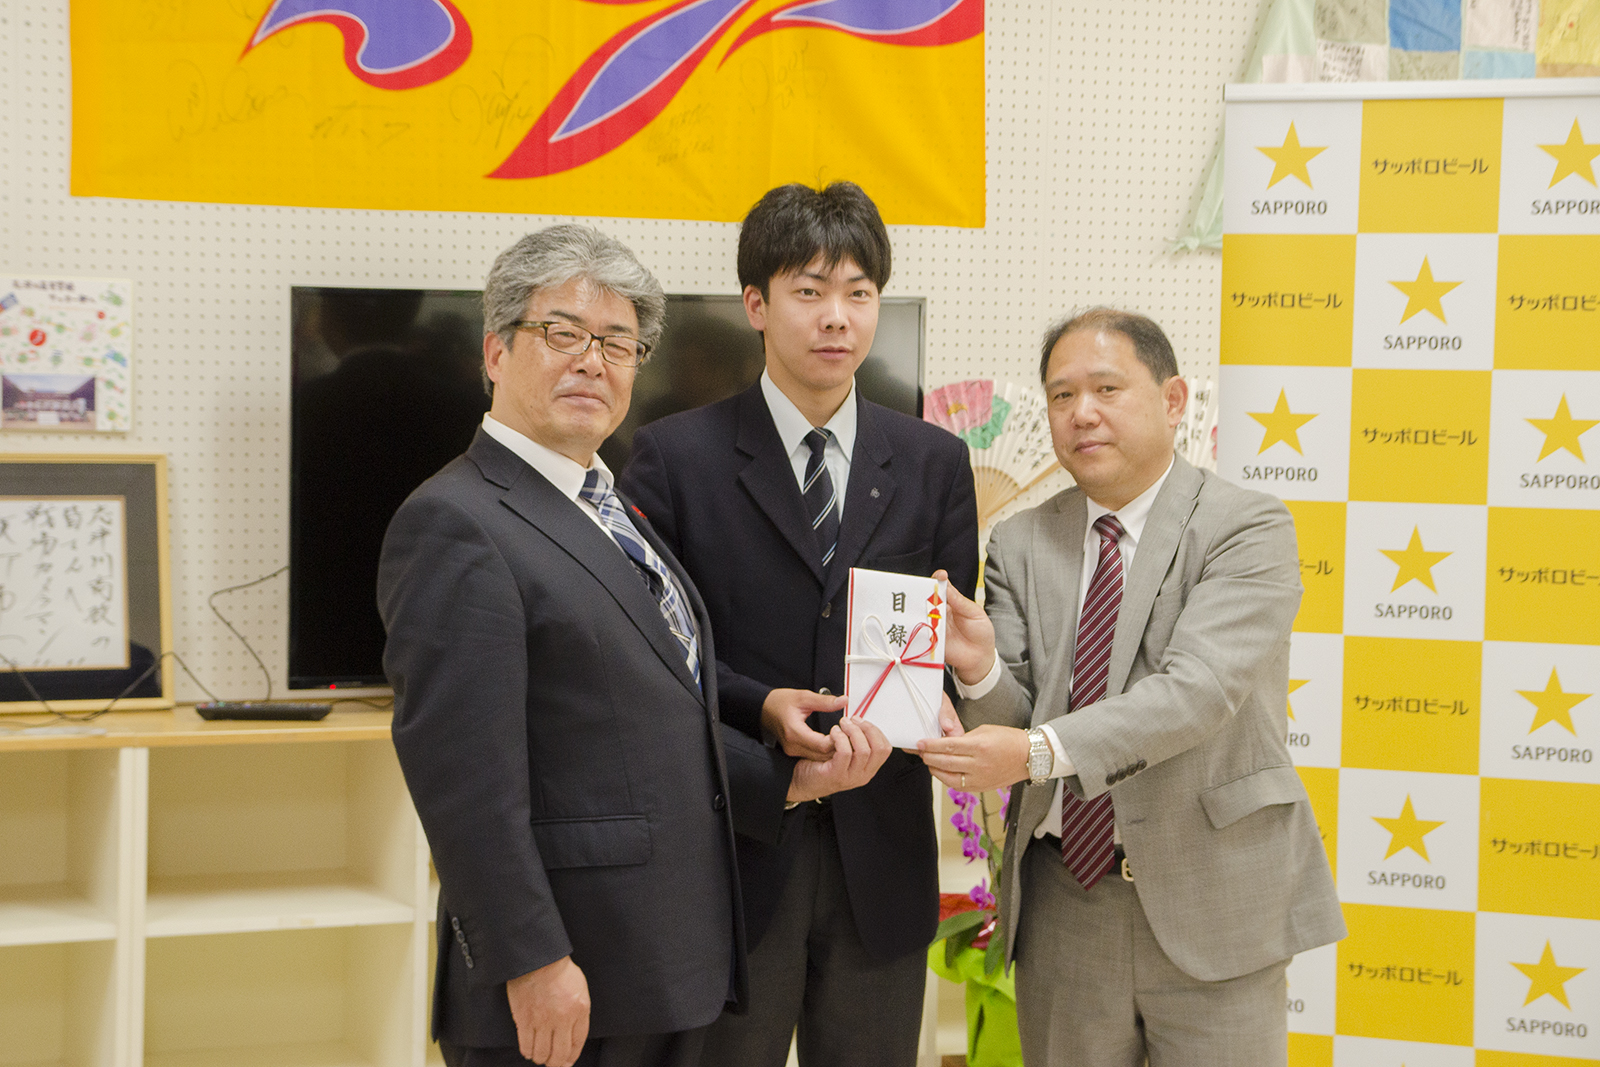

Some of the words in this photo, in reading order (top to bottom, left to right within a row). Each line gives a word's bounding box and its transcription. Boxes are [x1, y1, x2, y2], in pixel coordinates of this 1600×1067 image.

[1374, 158, 1489, 175] サッポロビール
[1251, 200, 1328, 215] SAPPORO
[1231, 292, 1343, 309] サッポロビール
[1384, 335, 1462, 351] SAPPORO
[1362, 427, 1478, 446] サッポロビール
[1242, 465, 1318, 482] SAPPORO
[1520, 473, 1600, 490] SAPPORO
[1498, 567, 1600, 586] サッポロビー
[886, 591, 908, 651] 目録
[1375, 603, 1453, 621] SAPPORO
[1354, 695, 1469, 716] サッポロビール
[1512, 744, 1593, 764] SAPPORO
[1368, 870, 1446, 890] SAPPORO
[1348, 963, 1463, 986] サッポロビール
[1506, 1017, 1588, 1038] SAPPORO
